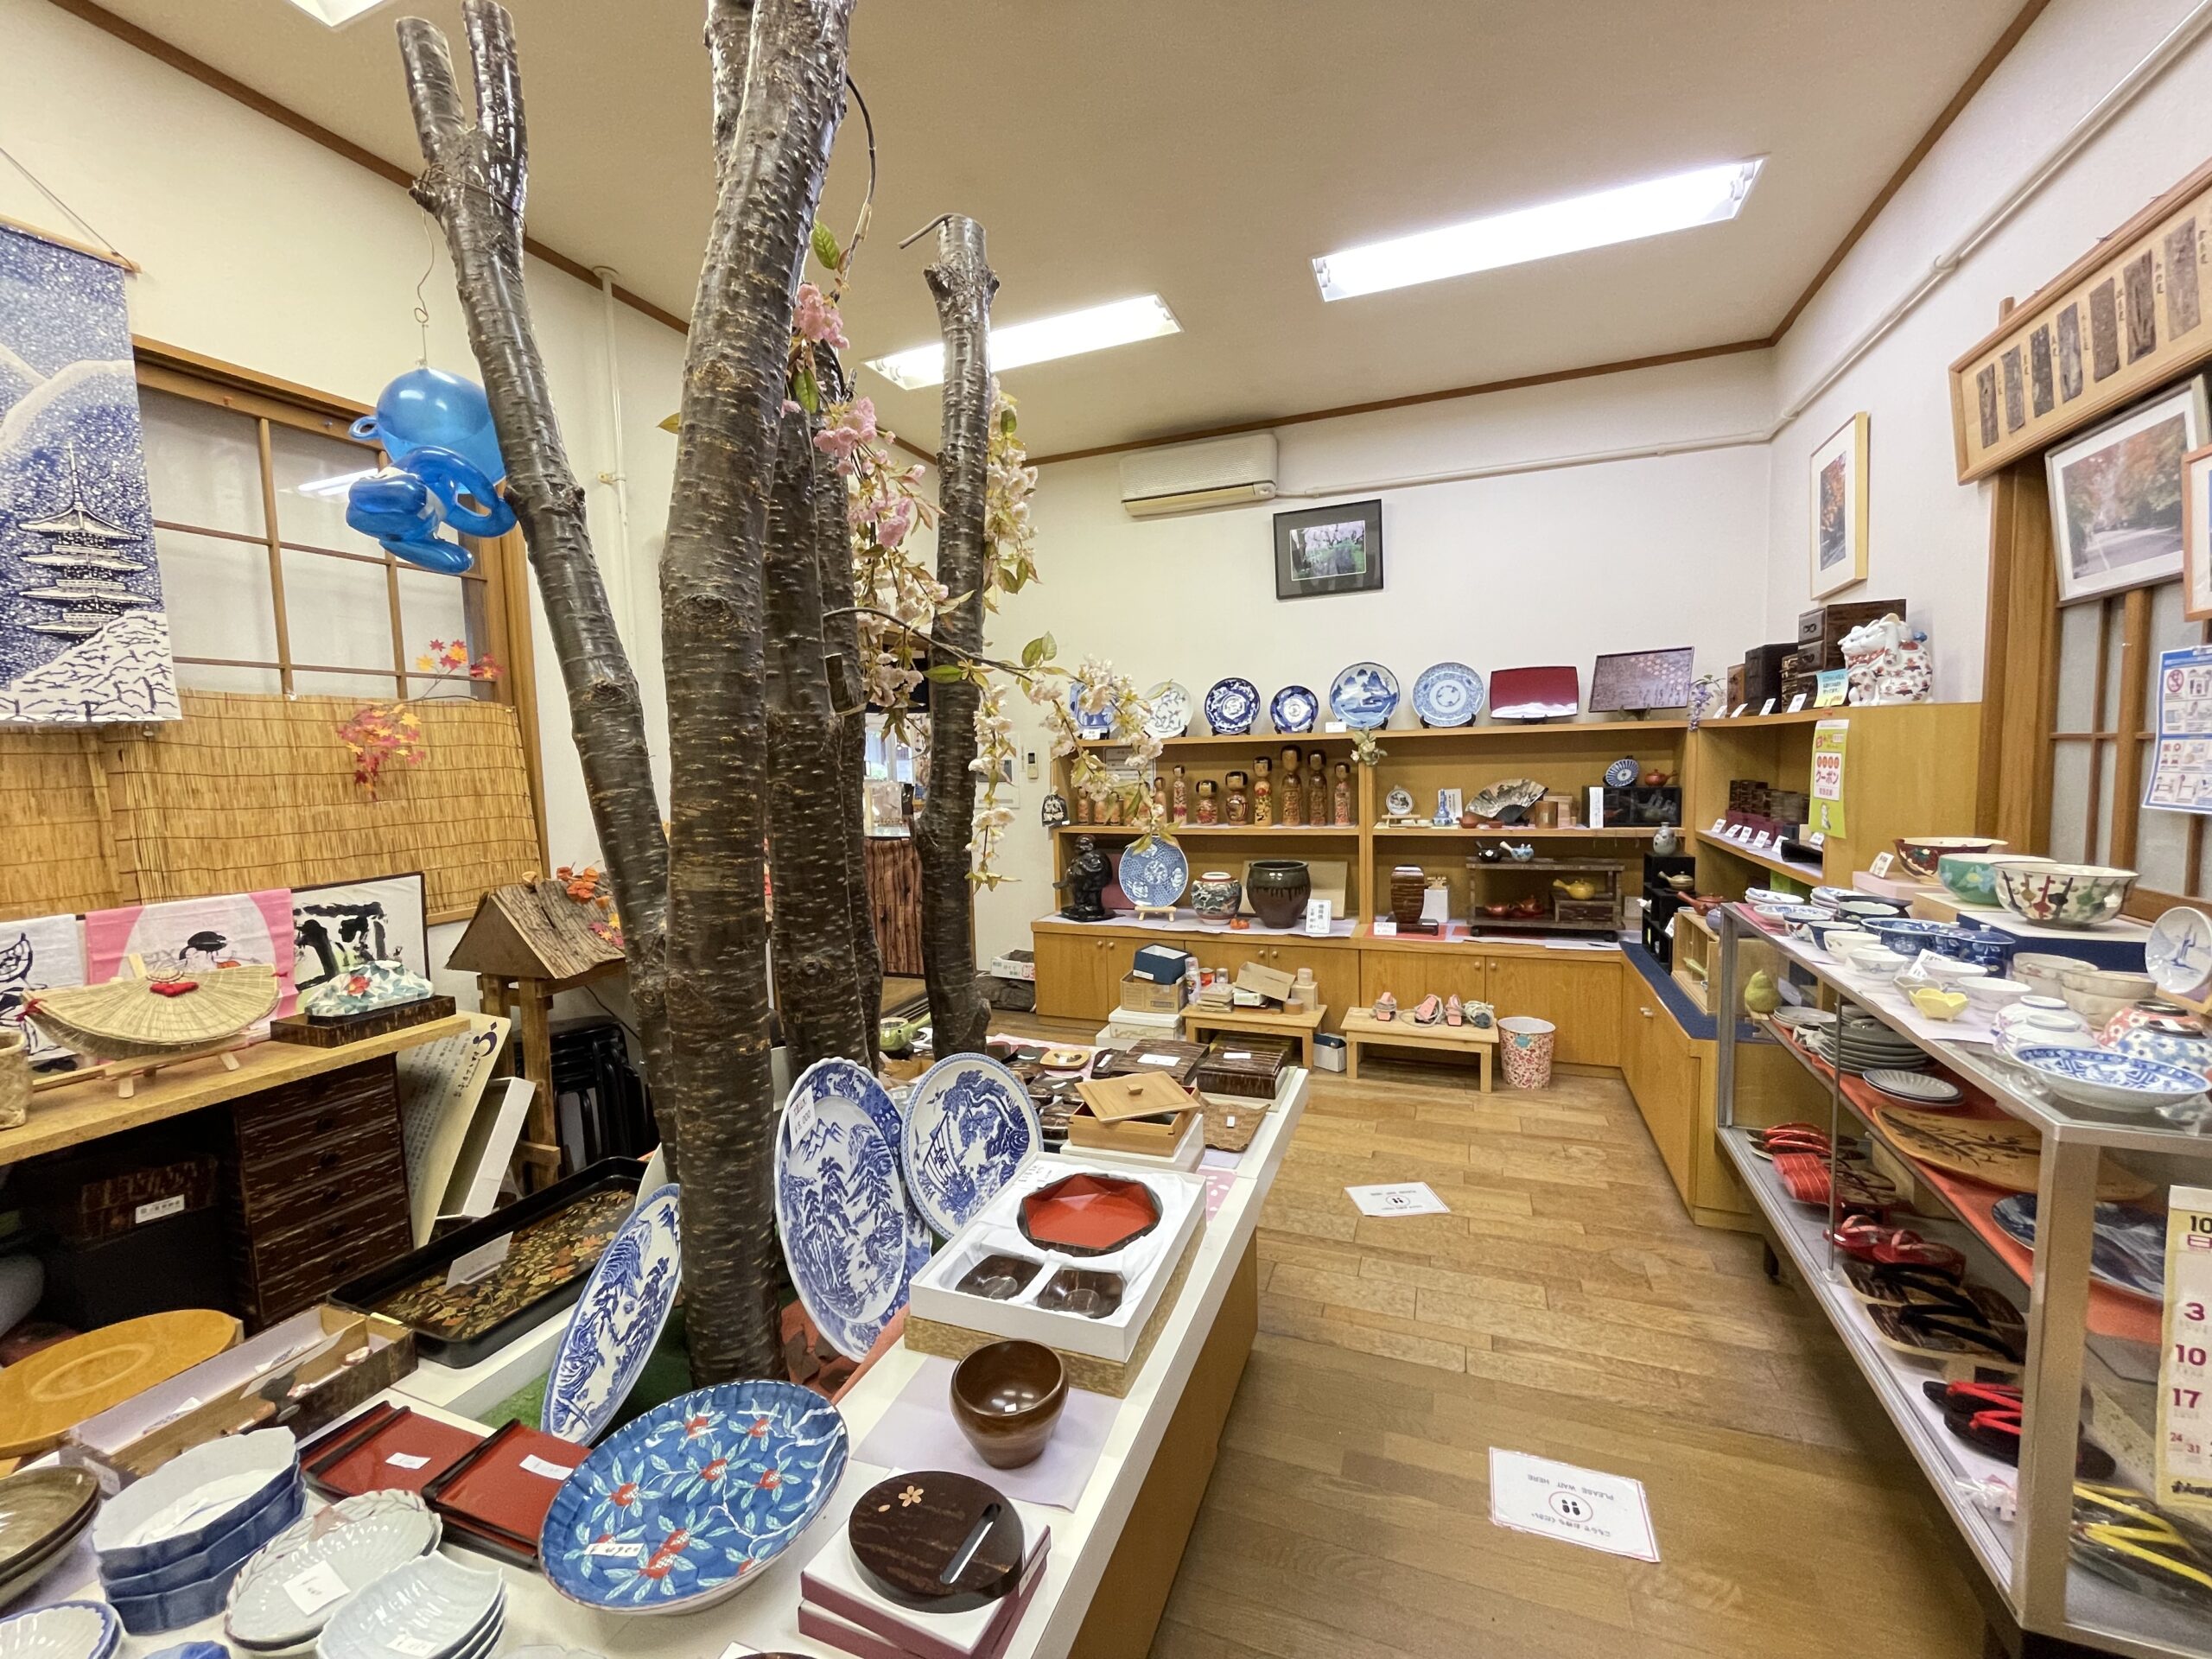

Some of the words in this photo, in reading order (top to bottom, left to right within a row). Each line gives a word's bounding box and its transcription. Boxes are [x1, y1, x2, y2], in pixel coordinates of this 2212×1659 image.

[1815, 771, 1839, 785] クーポン
[2183, 1301, 2205, 1321] 3
[2175, 1344, 2207, 1366] 10
[2172, 1388, 2202, 1408] 17
[2170, 1432, 2183, 1442] 24
[2187, 1443, 2201, 1454] 31
[1529, 1474, 1549, 1484] HERE
[1557, 1482, 1576, 1491] WAIT
[1582, 1487, 1614, 1500] PLEASE
